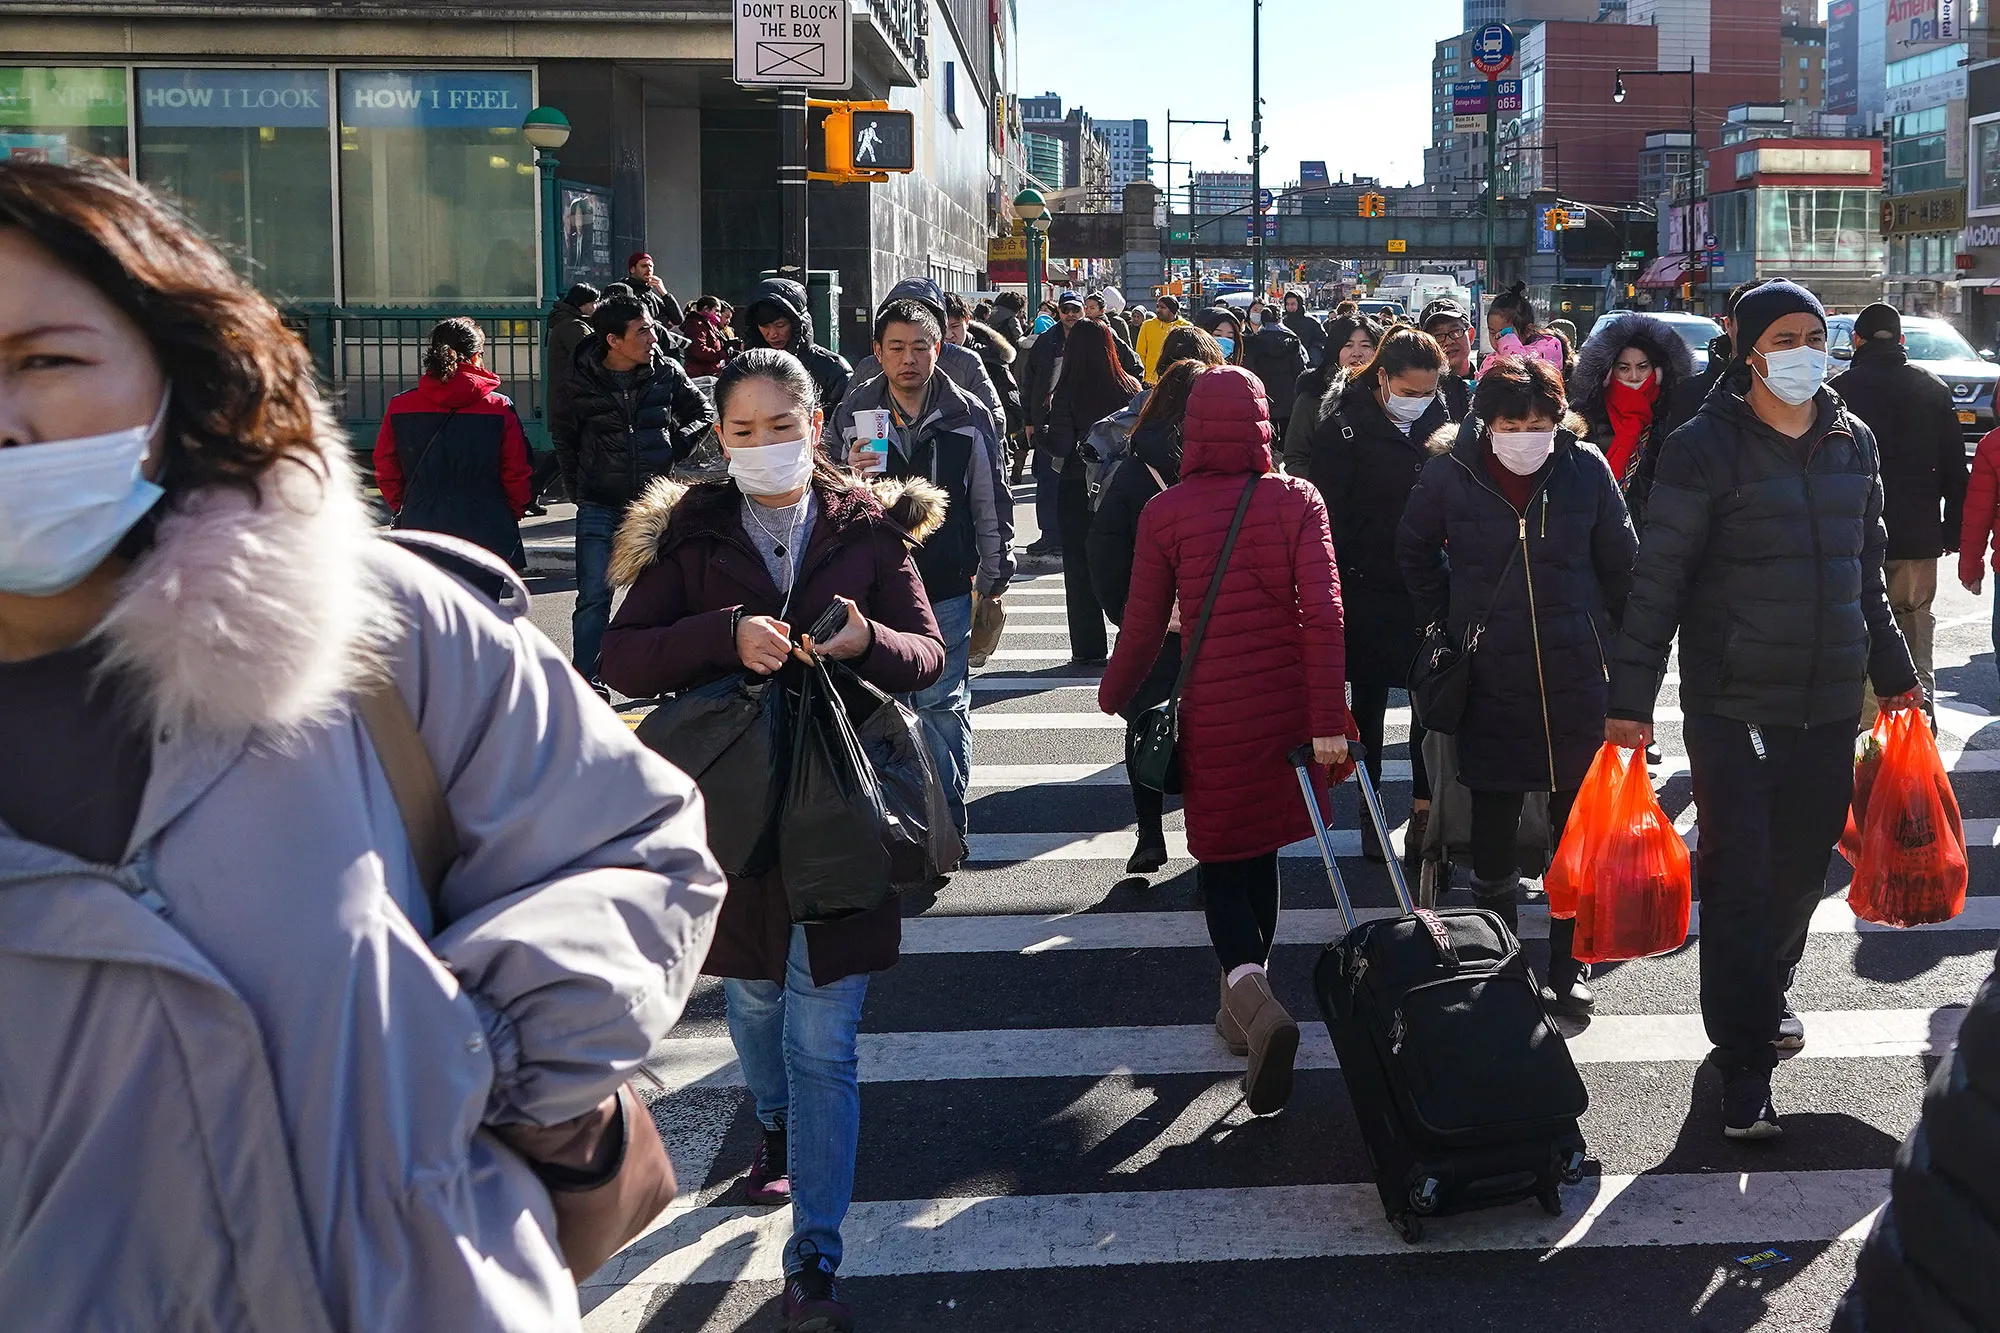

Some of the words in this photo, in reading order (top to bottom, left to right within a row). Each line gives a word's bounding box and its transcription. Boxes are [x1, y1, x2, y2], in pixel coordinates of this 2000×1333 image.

[742, 3, 784, 18] DON'T
[790, 4, 837, 19] BLOCK
[760, 23, 786, 37] THE
[793, 23, 821, 38] BOX
[1475, 59, 1483, 68] NO
[1483, 56, 1510, 73] STANDING
[1498, 82, 1516, 94] Q65
[146, 88, 213, 108] HOW
[220, 88, 232, 108] I
[240, 88, 321, 108] LOOK
[355, 89, 422, 109] HOW
[431, 90, 440, 109] I
[448, 90, 518, 110] FEEL
[1498, 97, 1516, 109] Q65
[1414, 908, 1451, 951] REW
